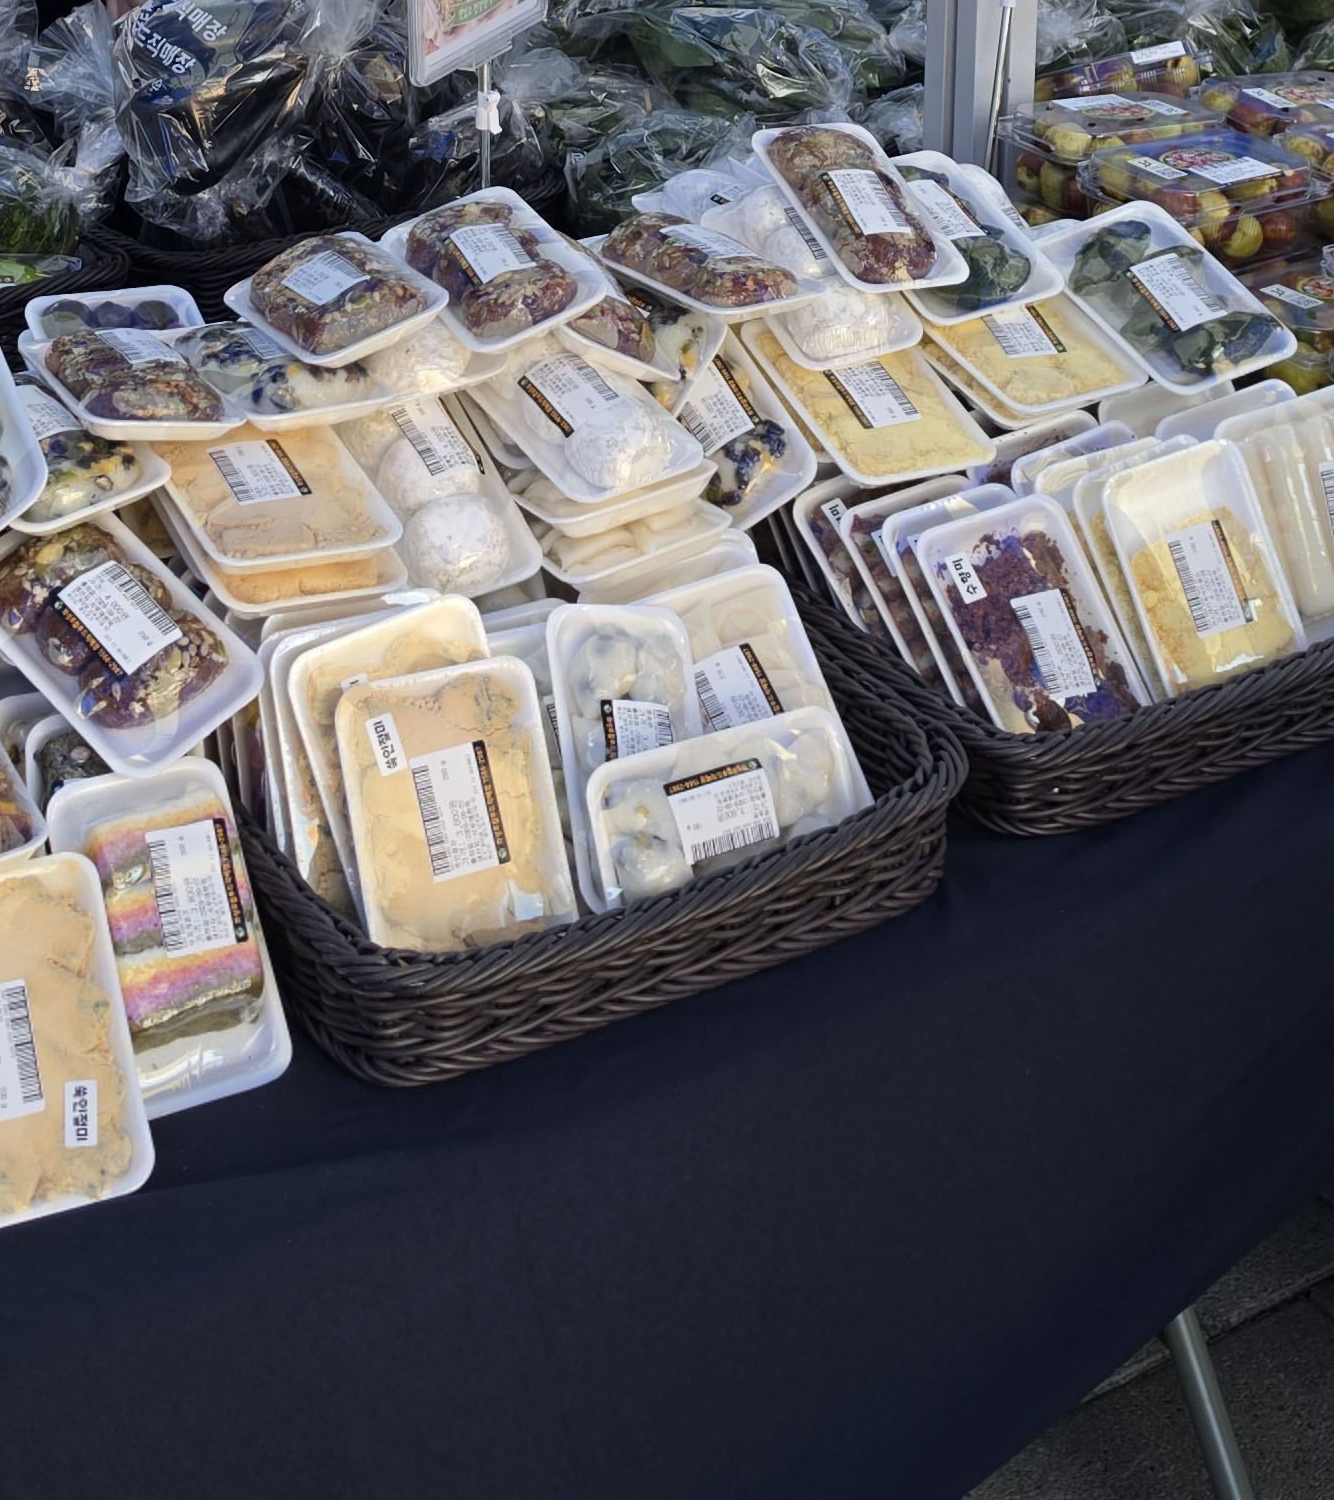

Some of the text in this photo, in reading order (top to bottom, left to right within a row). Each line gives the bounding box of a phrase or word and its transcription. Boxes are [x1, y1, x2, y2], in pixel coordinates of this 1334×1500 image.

[951, 556, 978, 597] 수향미
[372, 718, 398, 770] 쑥인절미
[70, 1085, 92, 1142] 쑥인절미
